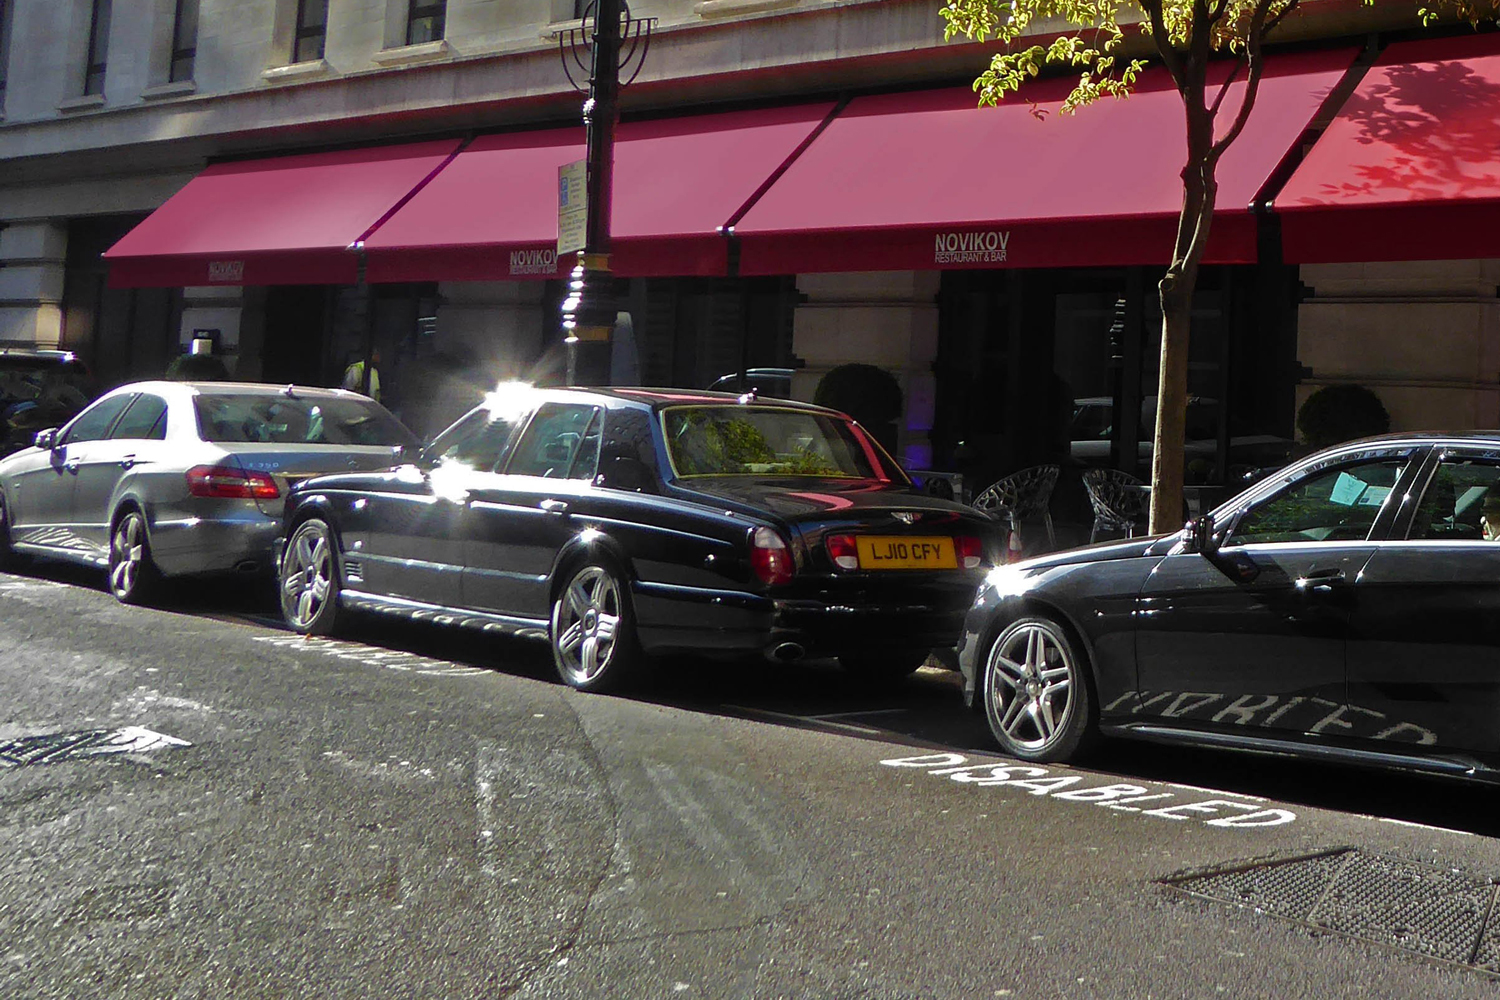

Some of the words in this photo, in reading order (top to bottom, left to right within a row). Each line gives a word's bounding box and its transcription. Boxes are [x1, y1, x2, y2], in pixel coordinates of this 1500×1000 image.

[935, 231, 1010, 252] NOVIKOV
[510, 249, 558, 266] NOVIKOV
[934, 252, 983, 263] RESTAURANT
[990, 251, 1007, 262] BAR
[911, 544, 941, 560] CFY
[880, 753, 1296, 828] DISABLED
